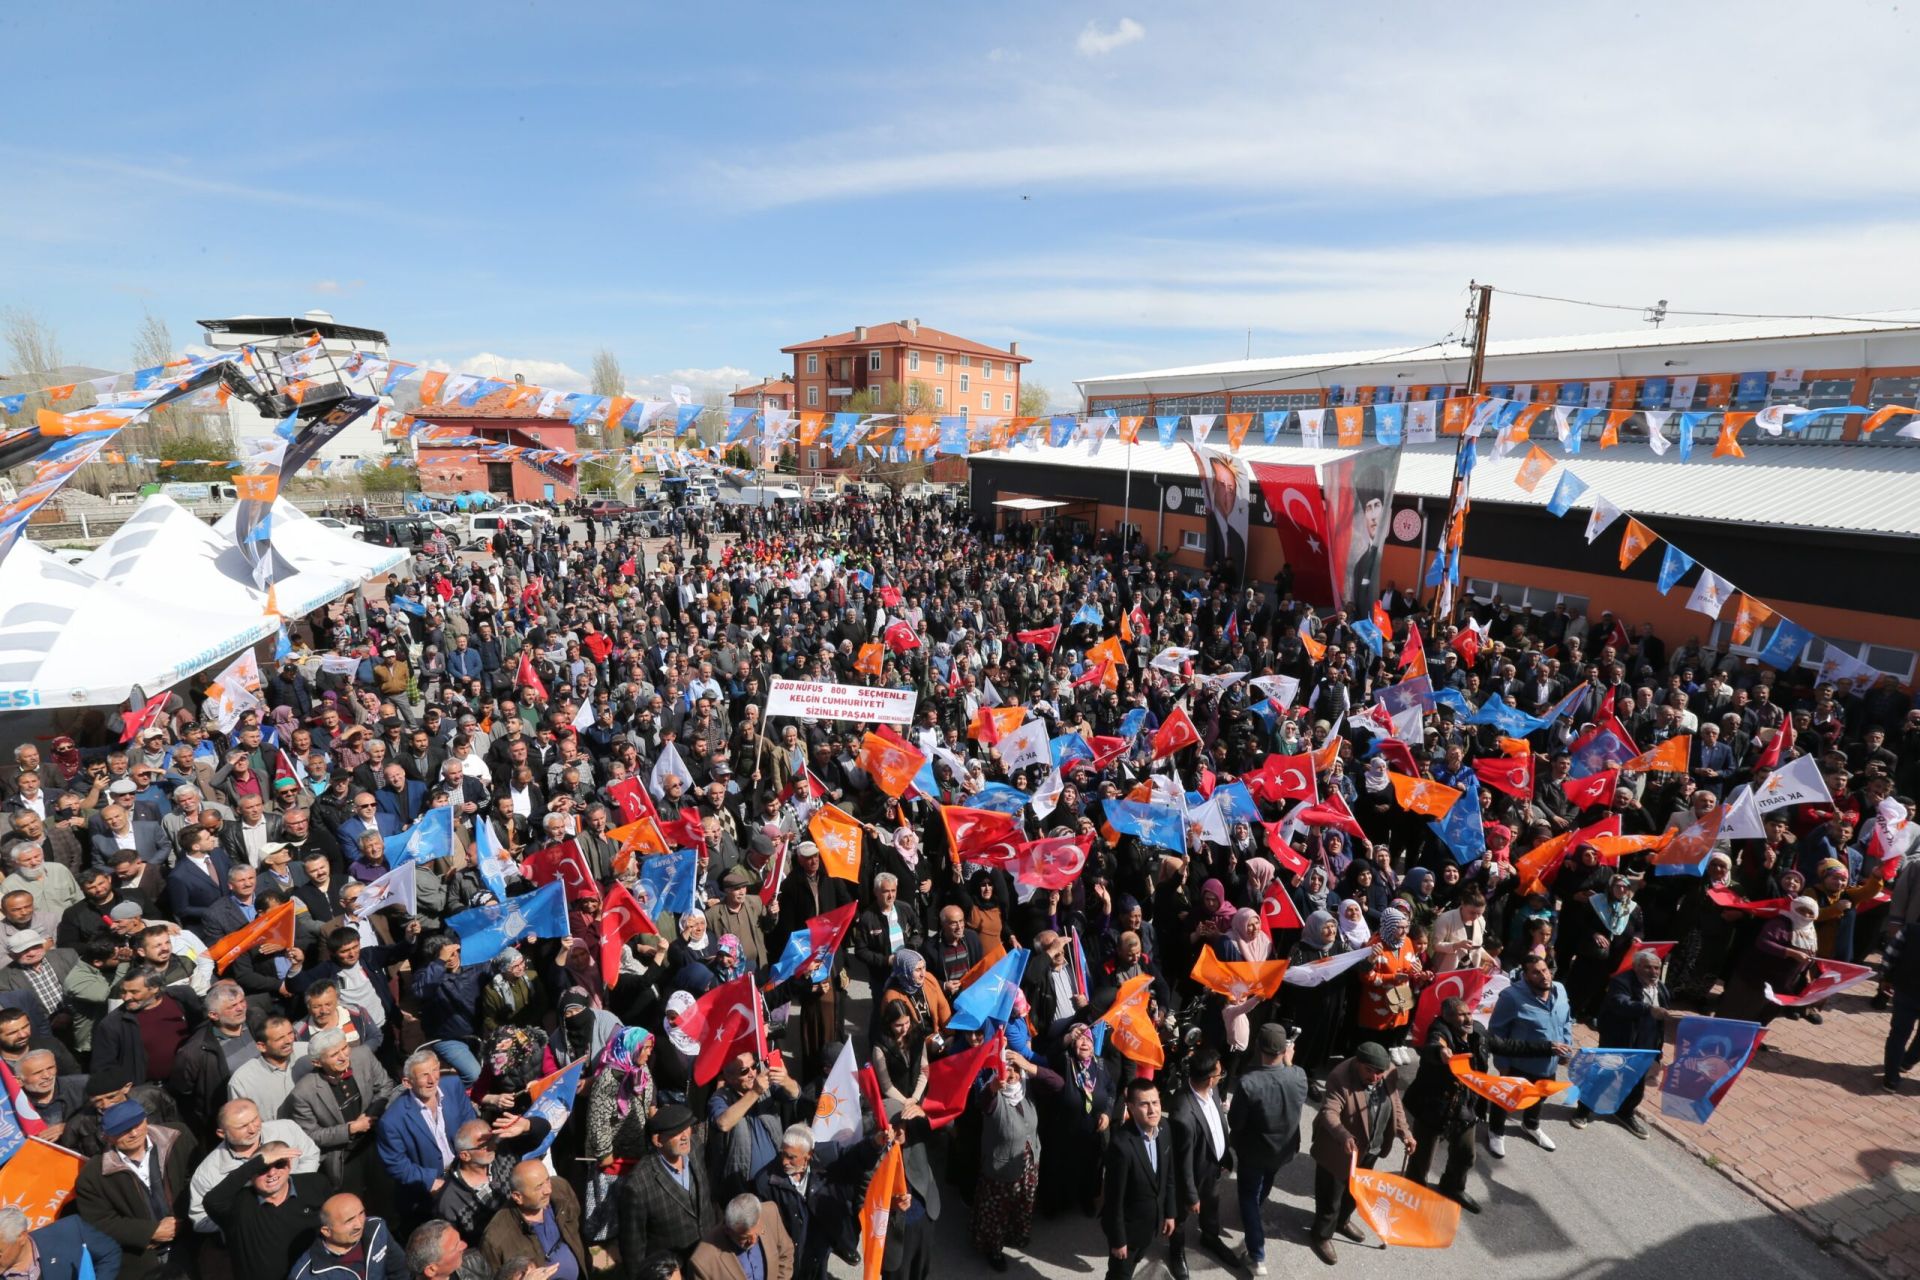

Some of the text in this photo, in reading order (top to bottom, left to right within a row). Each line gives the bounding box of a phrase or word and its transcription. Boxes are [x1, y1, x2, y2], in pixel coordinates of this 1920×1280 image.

[774, 682, 908, 701] 2000 NÜFUS 800 SEÇMENLE
[789, 694, 885, 709] KELGİN CUMHURİYETİ
[805, 707, 840, 717] SİZİNLE
[841, 710, 875, 720] PAŞAM
[1463, 1073, 1484, 1088] AK
